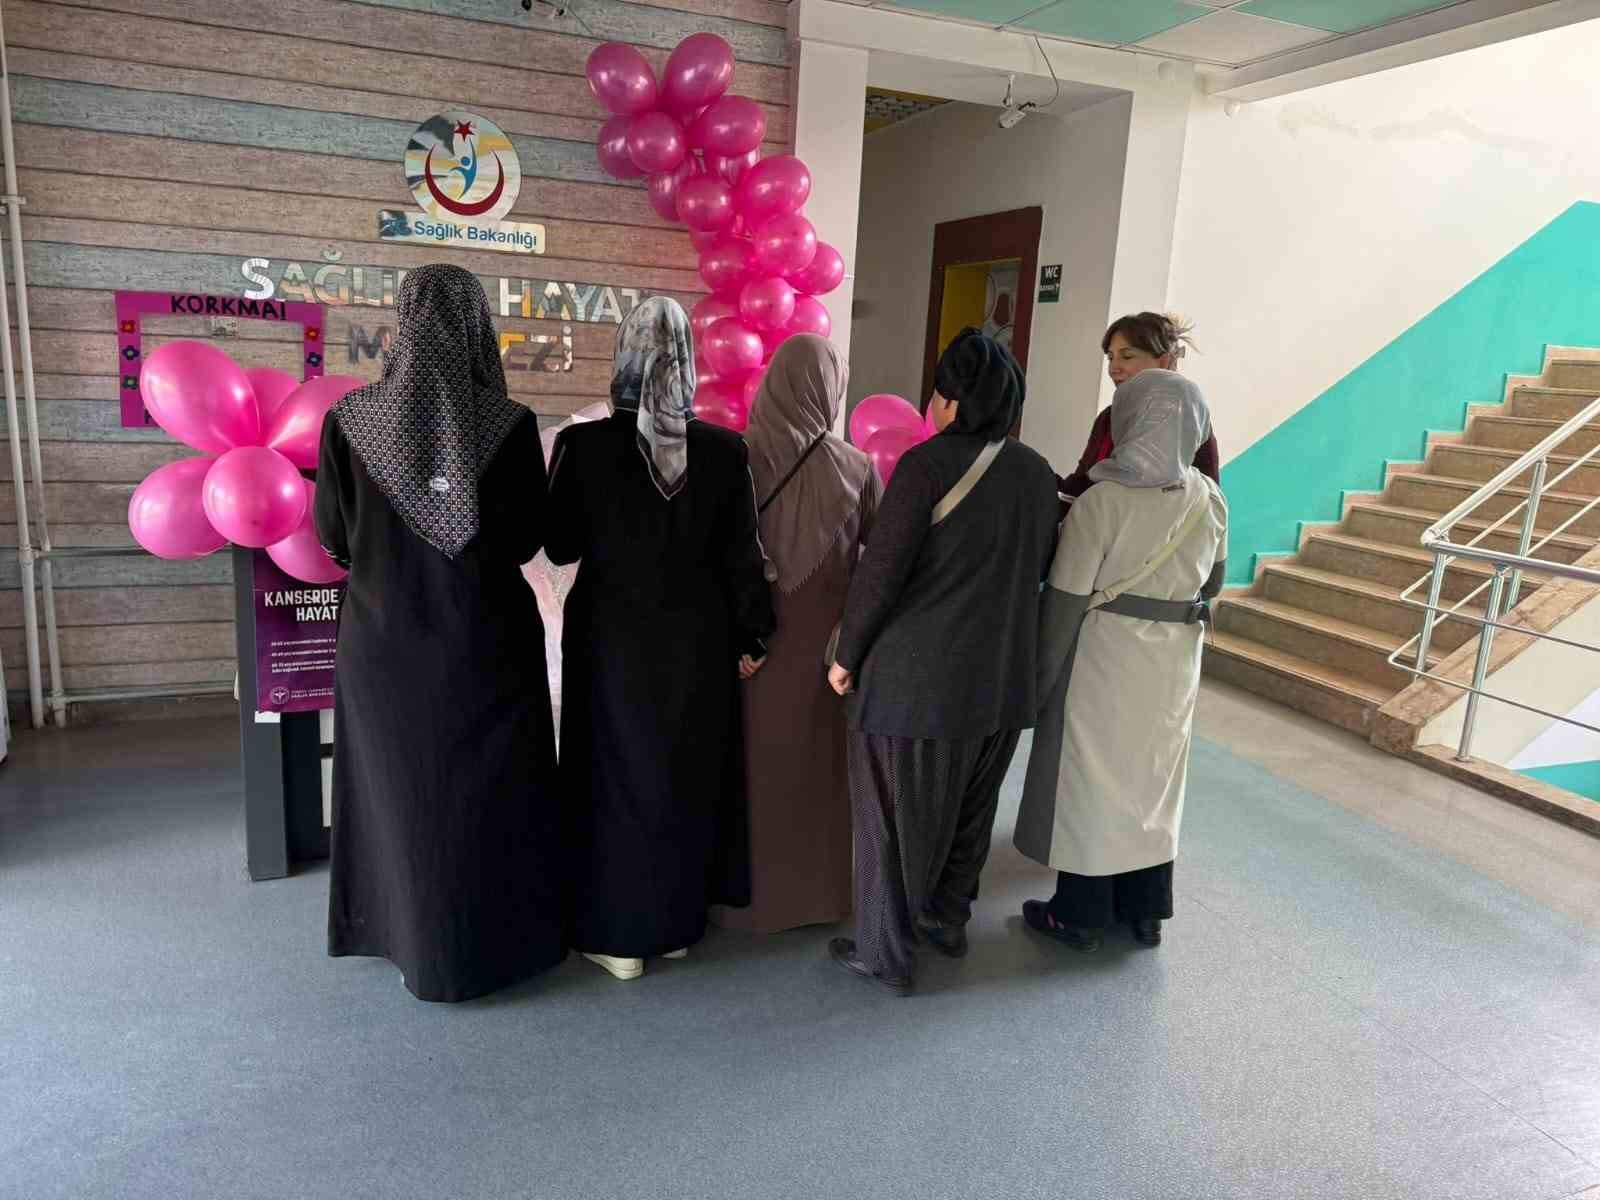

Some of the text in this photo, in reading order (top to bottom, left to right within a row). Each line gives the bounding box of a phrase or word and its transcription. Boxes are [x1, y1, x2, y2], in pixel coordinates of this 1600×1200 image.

[414, 220, 537, 249] Sağlık Bakanlığı
[241, 249, 408, 306] SAĞLI
[1045, 266, 1059, 280] WC
[264, 588, 339, 607] KANSERDE
[296, 605, 338, 621] HAYAT
